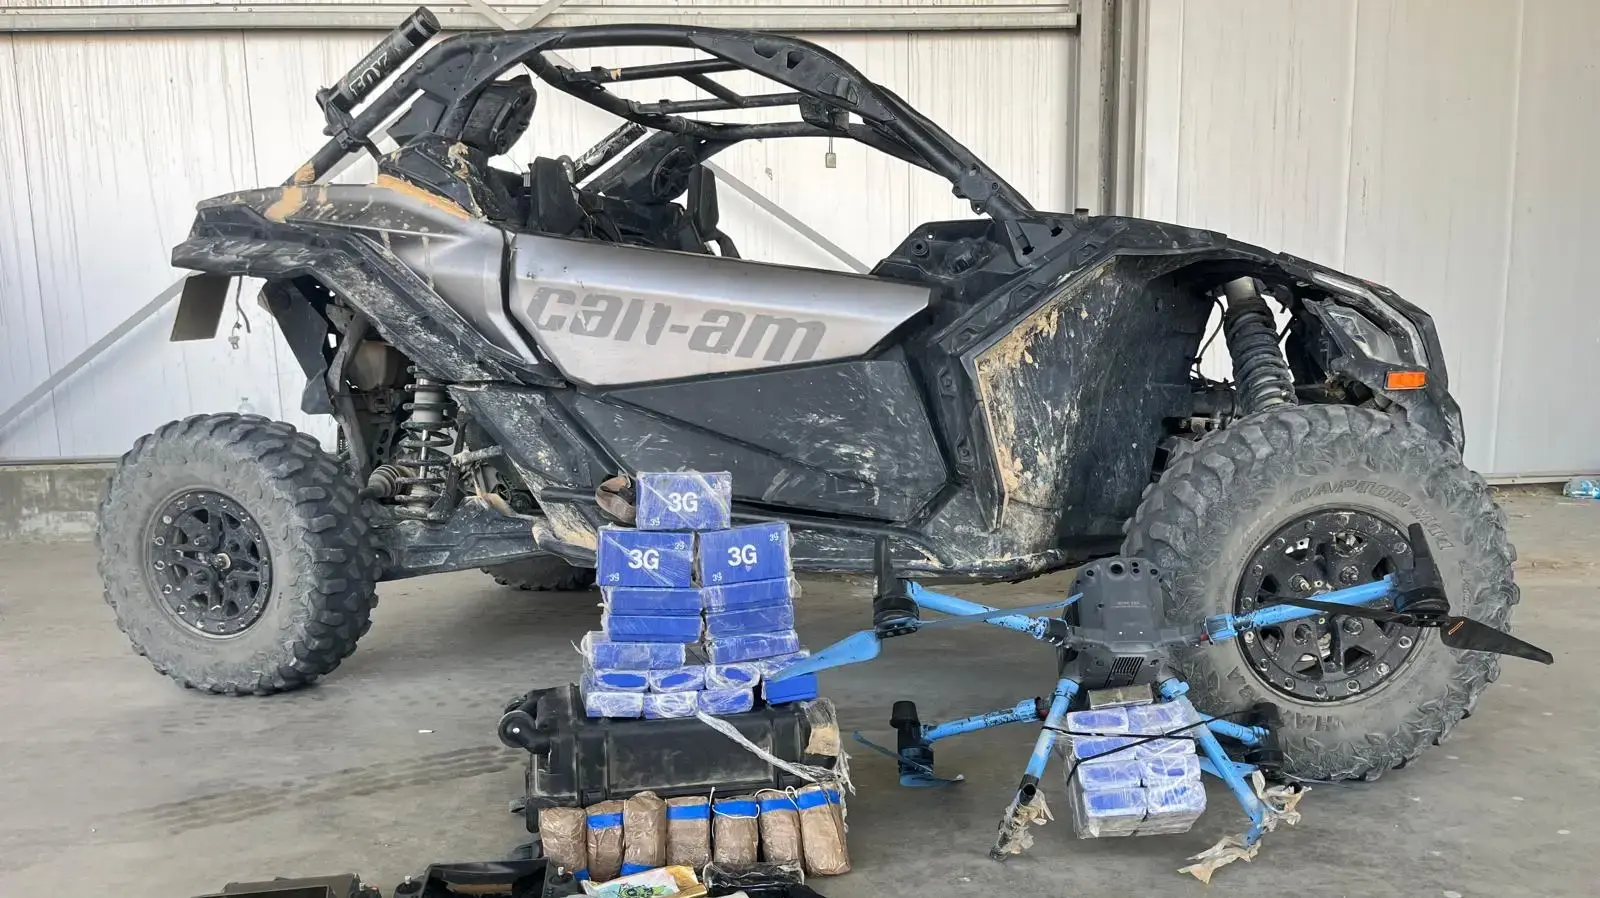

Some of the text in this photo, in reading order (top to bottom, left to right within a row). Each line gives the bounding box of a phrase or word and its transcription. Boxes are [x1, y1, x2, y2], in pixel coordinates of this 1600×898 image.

[349, 51, 388, 97] FOX
[526, 286, 827, 362] can-am
[668, 491, 698, 513] 3G
[1290, 479, 1411, 508] RAPTOR
[628, 549, 660, 570] 3G
[727, 544, 758, 567] 3G
